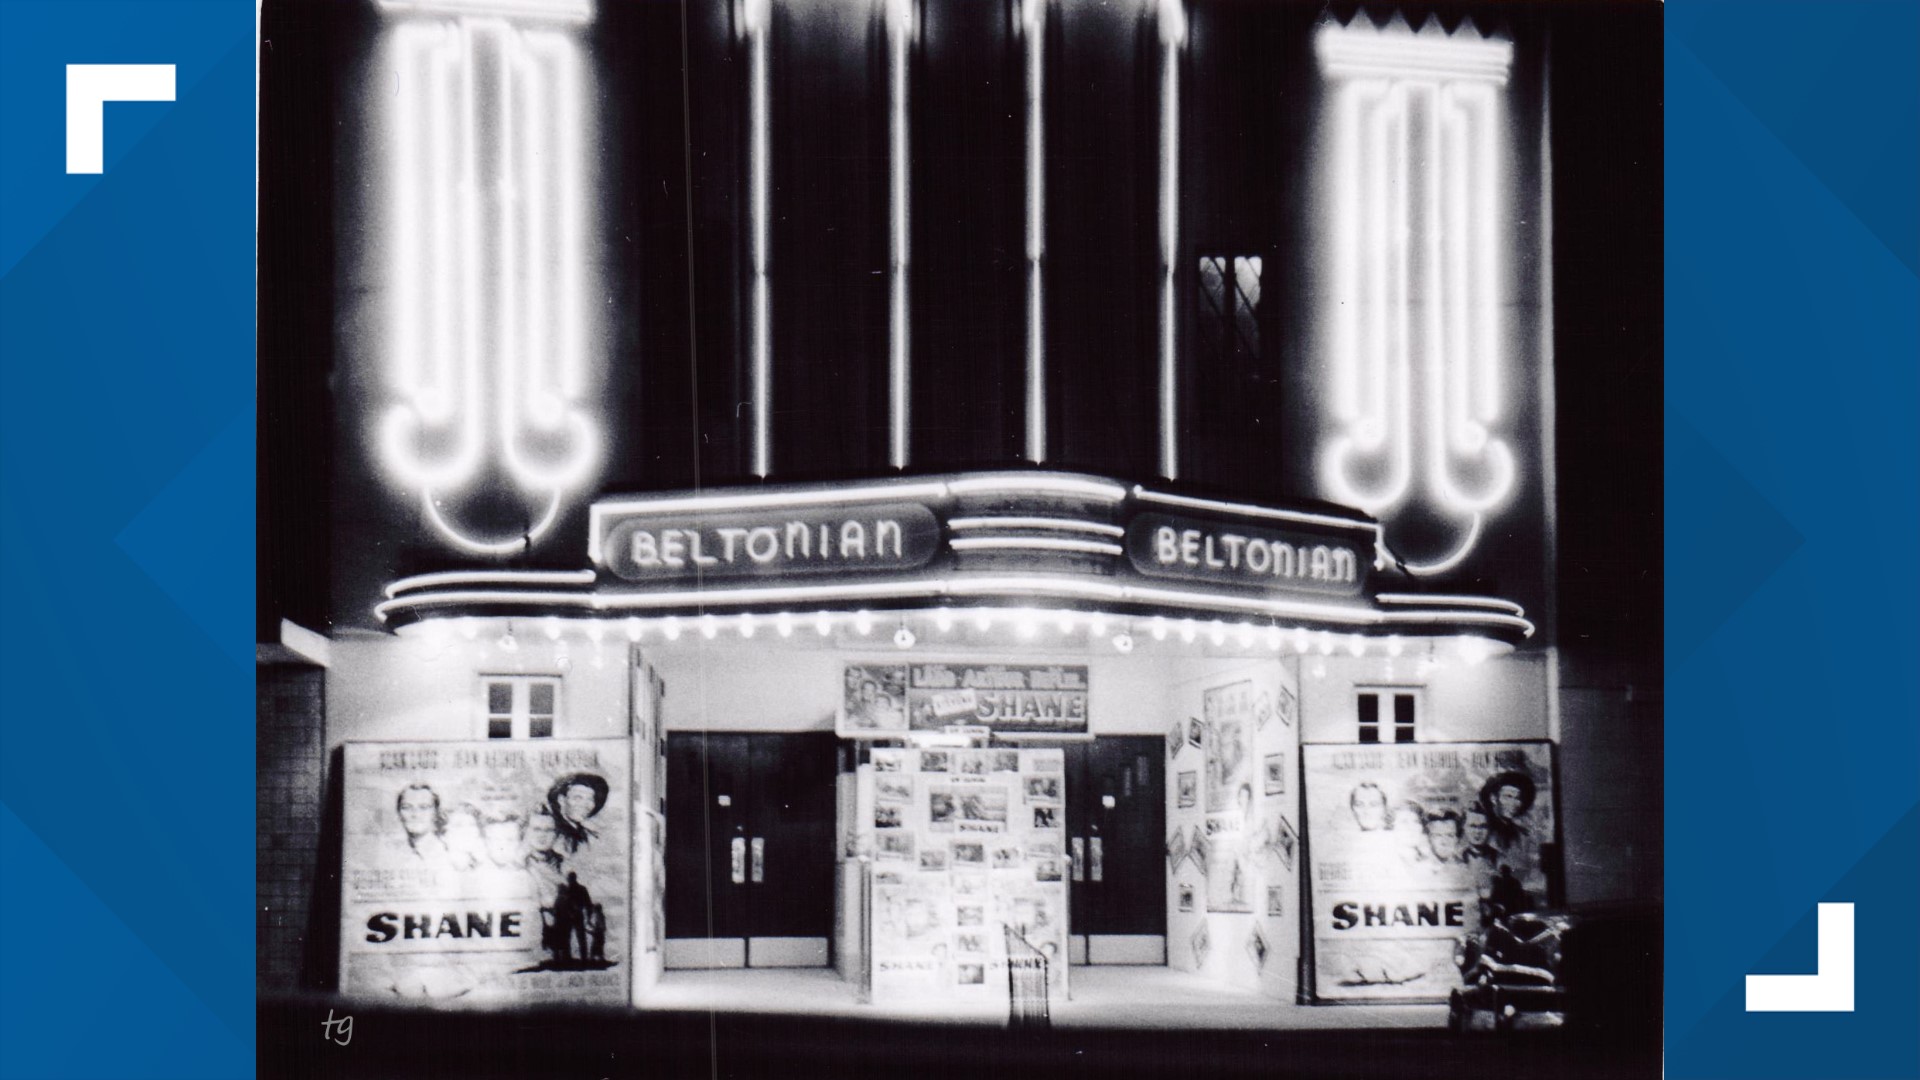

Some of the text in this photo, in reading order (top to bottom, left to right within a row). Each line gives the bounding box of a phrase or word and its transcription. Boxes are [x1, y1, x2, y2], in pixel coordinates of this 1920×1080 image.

[631, 519, 902, 567] BELTONIAN
[1156, 526, 1357, 582] BELTONIAN
[975, 691, 1087, 723] SHANE
[365, 911, 522, 943] SHANE
[1332, 902, 1464, 931] SHANE
